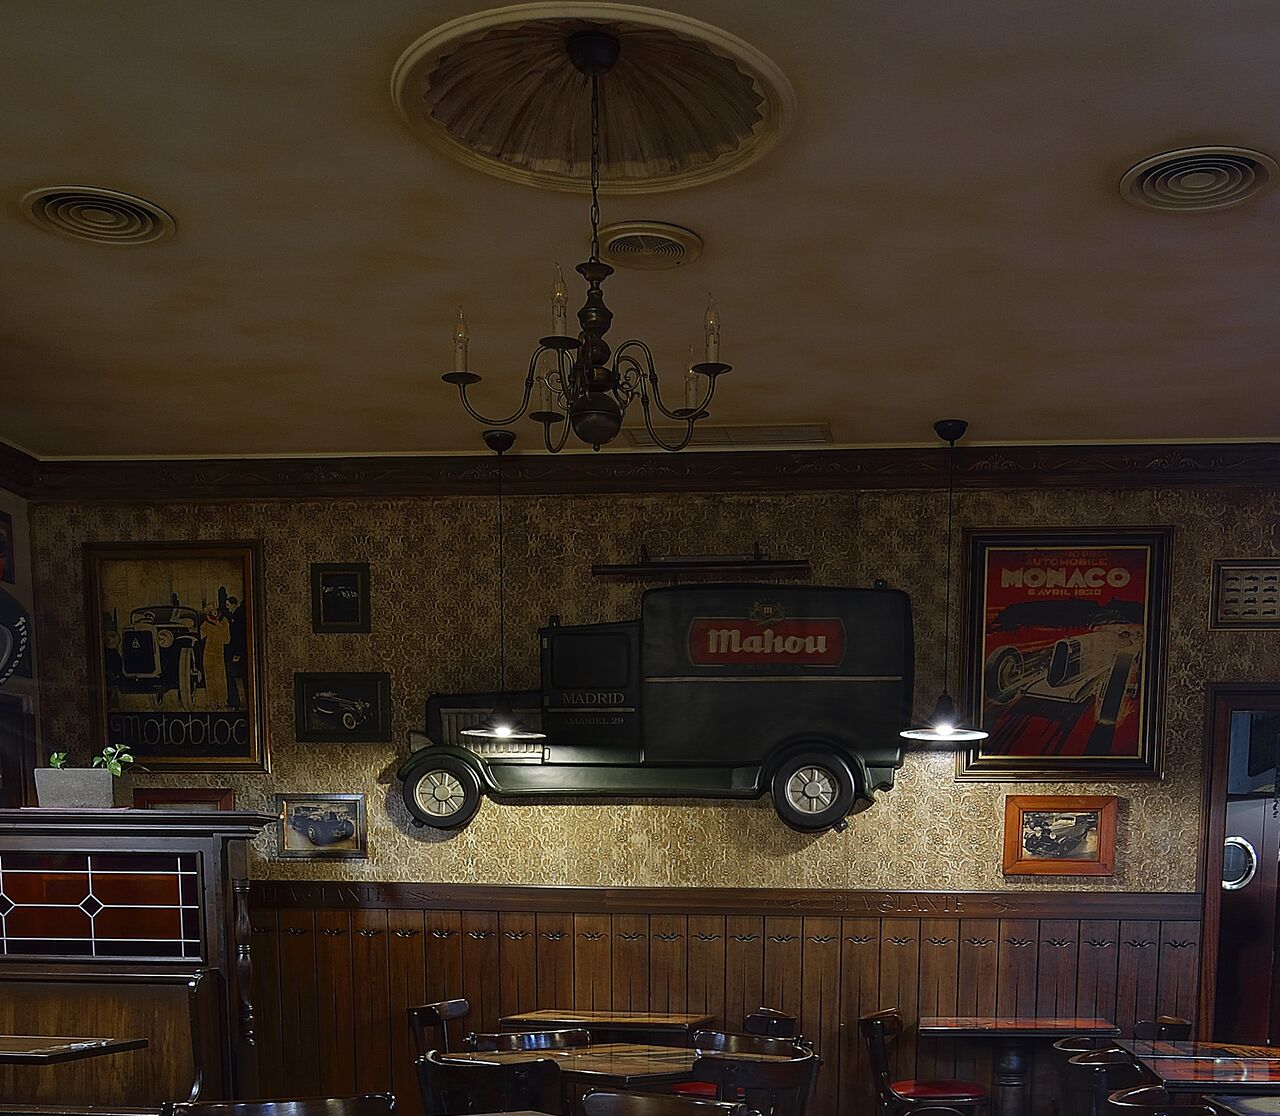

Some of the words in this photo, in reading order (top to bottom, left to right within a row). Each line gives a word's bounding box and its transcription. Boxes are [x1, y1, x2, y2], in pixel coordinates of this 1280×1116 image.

[1025, 558, 1108, 566] AUTOMOBILE
[1000, 567, 1131, 588] MONACO
[1037, 588, 1071, 596] AVRIL
[706, 628, 828, 654] Mahou
[561, 692, 625, 704] MADRID
